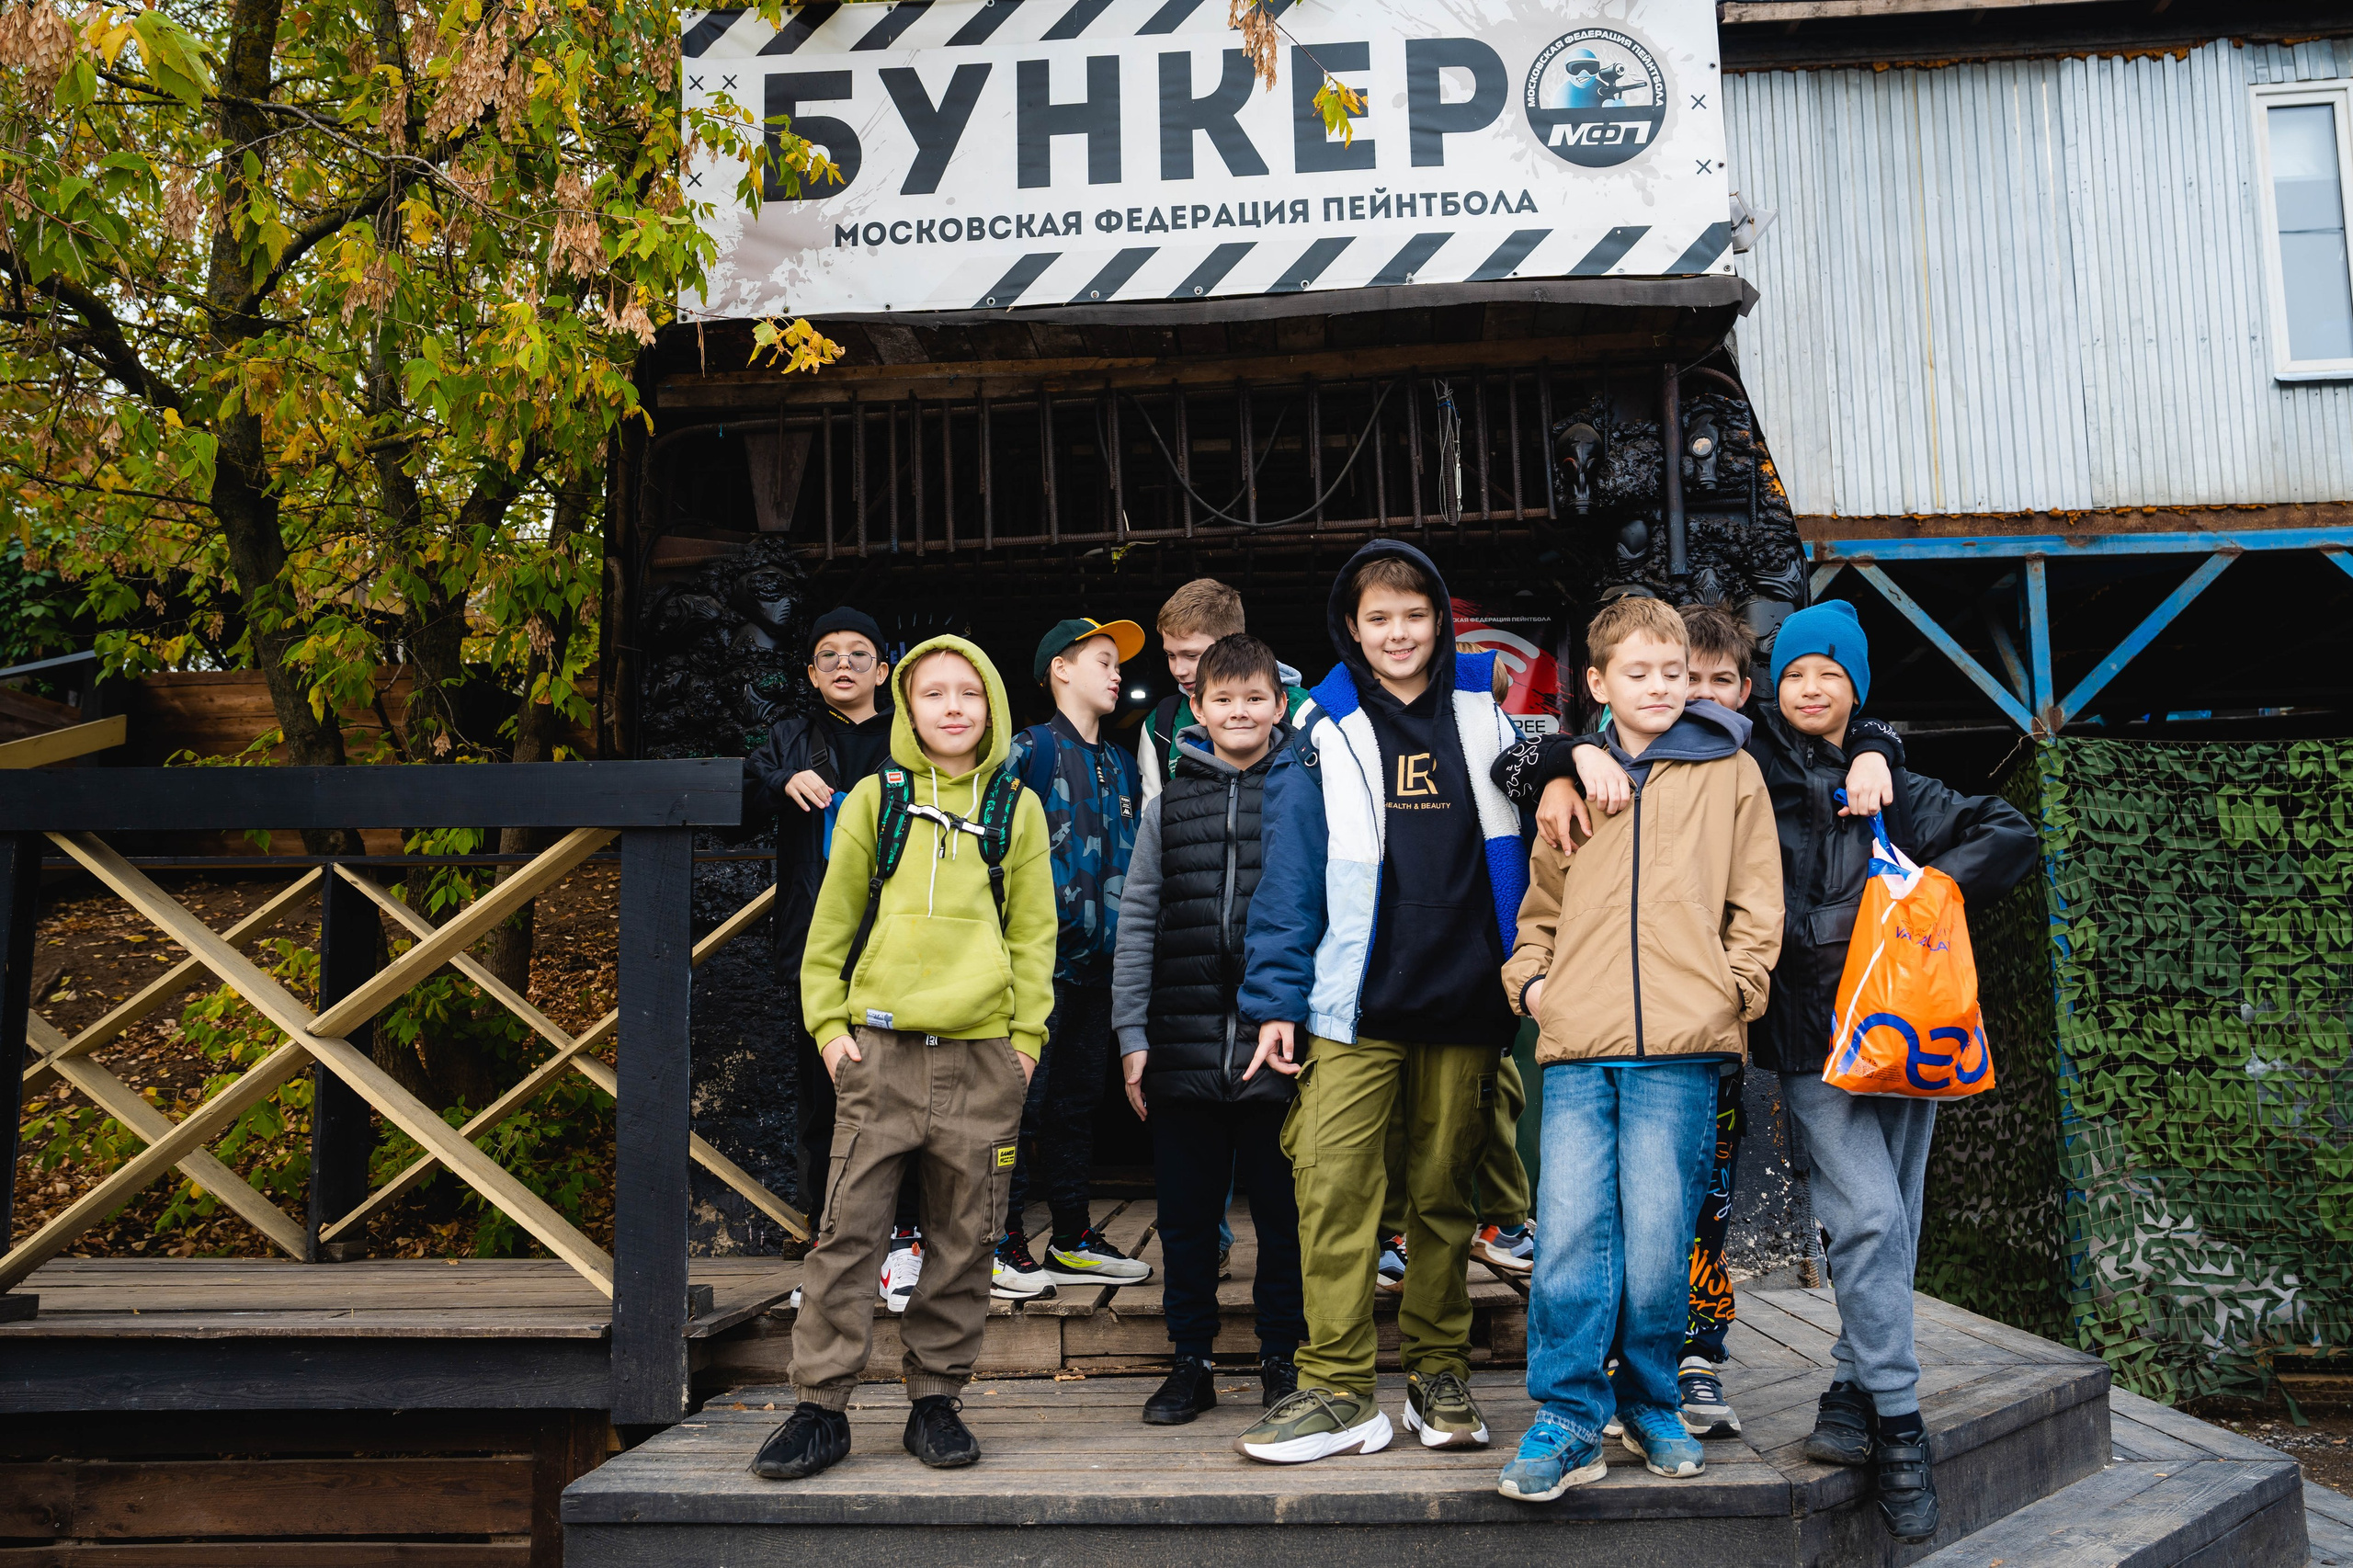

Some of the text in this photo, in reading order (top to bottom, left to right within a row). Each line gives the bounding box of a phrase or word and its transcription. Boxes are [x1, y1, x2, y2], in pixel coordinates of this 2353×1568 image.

[1527, 29, 1665, 108] МОСКОВСКАЯ ФЕДЕРАЦИЯ ПЕЙНТБОЛА
[763, 38, 1508, 202] БУНКЕР
[1547, 120, 1653, 147] МФП
[835, 187, 1540, 248] МОСКОВСКАЯ ФЕДЕРАЦИЯ ПЕЙНТБОЛА
